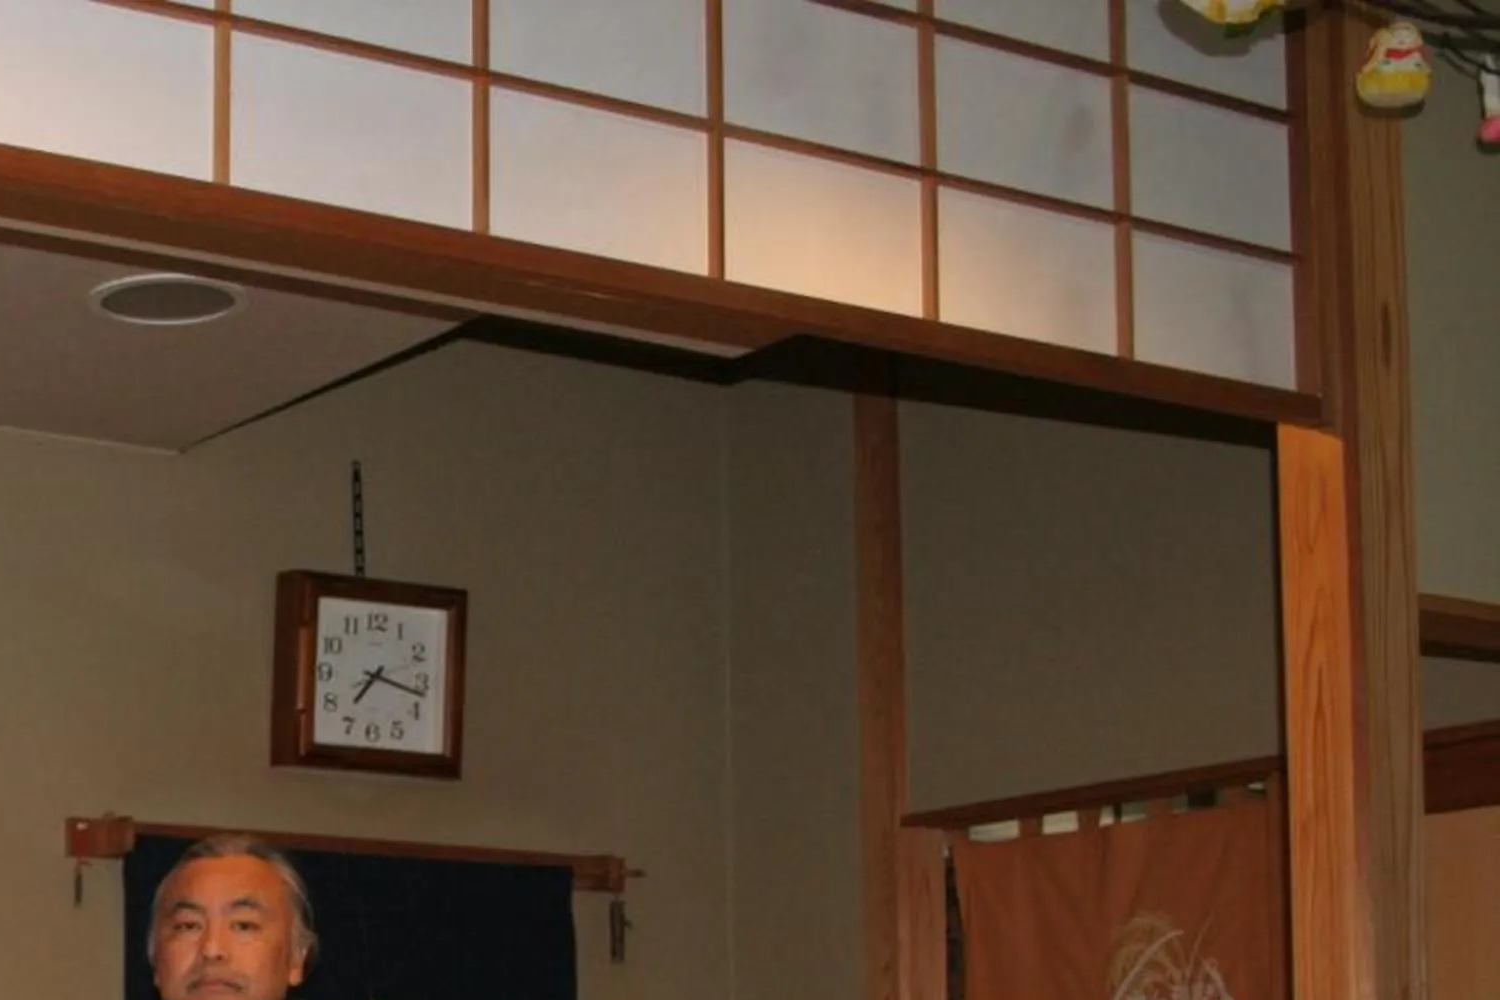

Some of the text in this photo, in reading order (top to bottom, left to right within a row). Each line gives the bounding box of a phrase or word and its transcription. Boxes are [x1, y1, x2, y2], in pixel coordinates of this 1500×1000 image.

[344, 617, 359, 635] 11
[367, 613, 388, 632] 12
[396, 623, 403, 641] 1
[323, 637, 342, 654] 10
[412, 642, 426, 663] 2
[318, 663, 333, 681] 9
[415, 673, 429, 694] 3
[323, 692, 338, 712] 8
[342, 717, 355, 735] 7
[365, 723, 380, 742] 6
[390, 721, 404, 739] 5
